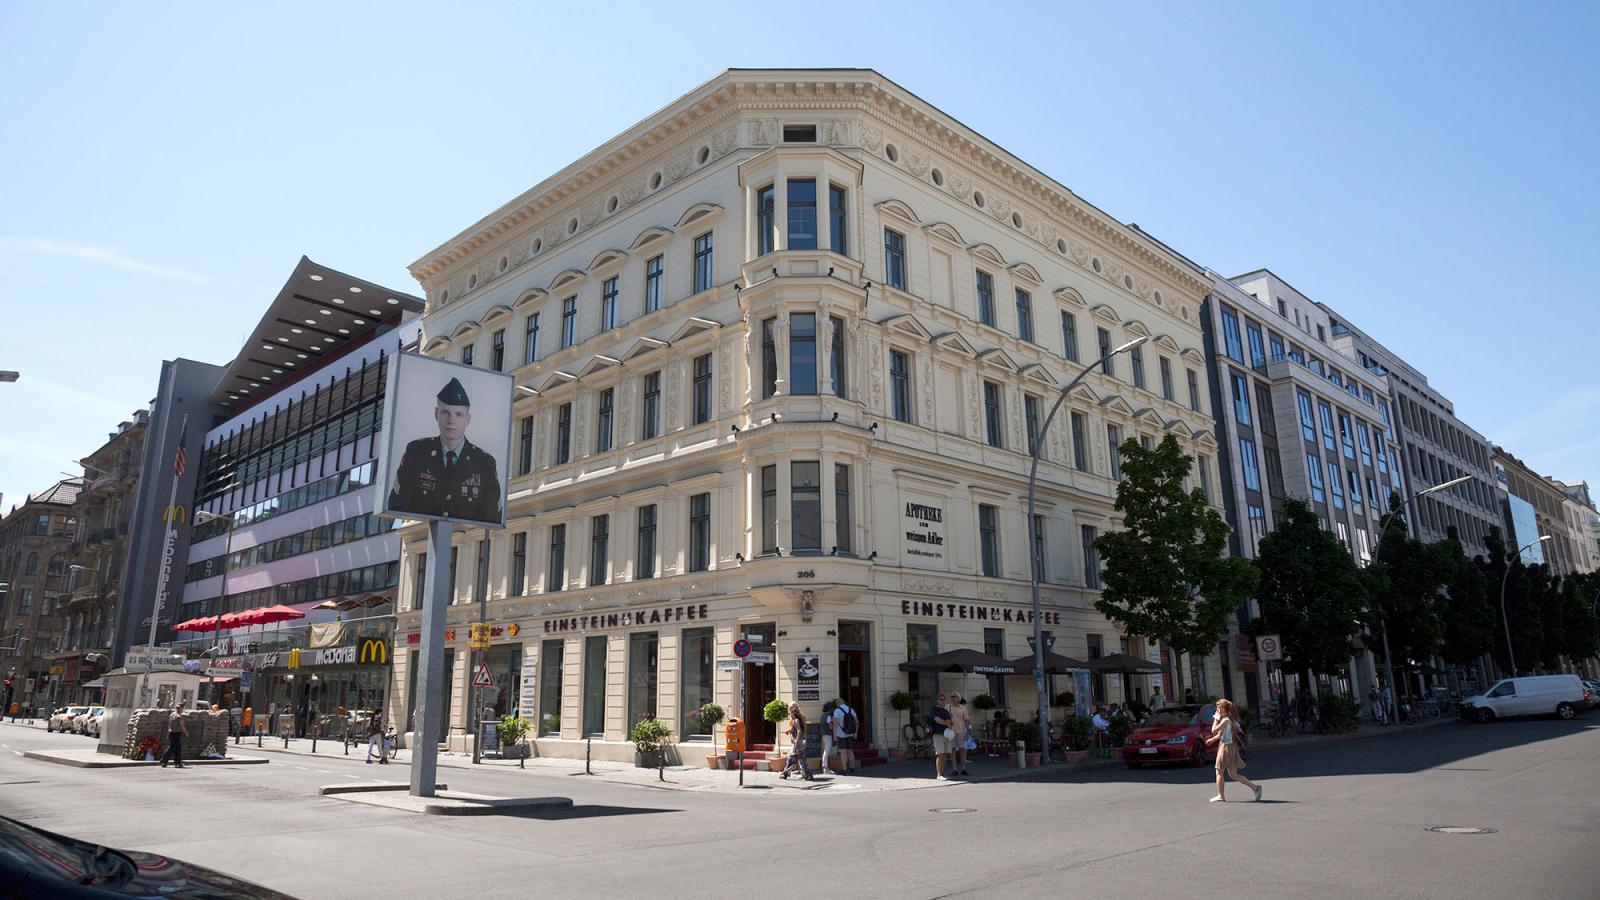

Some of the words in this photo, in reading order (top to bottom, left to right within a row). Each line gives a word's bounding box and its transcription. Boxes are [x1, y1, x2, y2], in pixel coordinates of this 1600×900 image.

[905, 502, 943, 523] APOTHEKE
[797, 570, 815, 578] 206
[544, 613, 618, 633] EINSTEIN
[635, 604, 708, 624] KAFFEE
[902, 600, 987, 620] EINSTEIN
[1264, 641, 1274, 649] 30
[315, 647, 356, 665] McDonal
